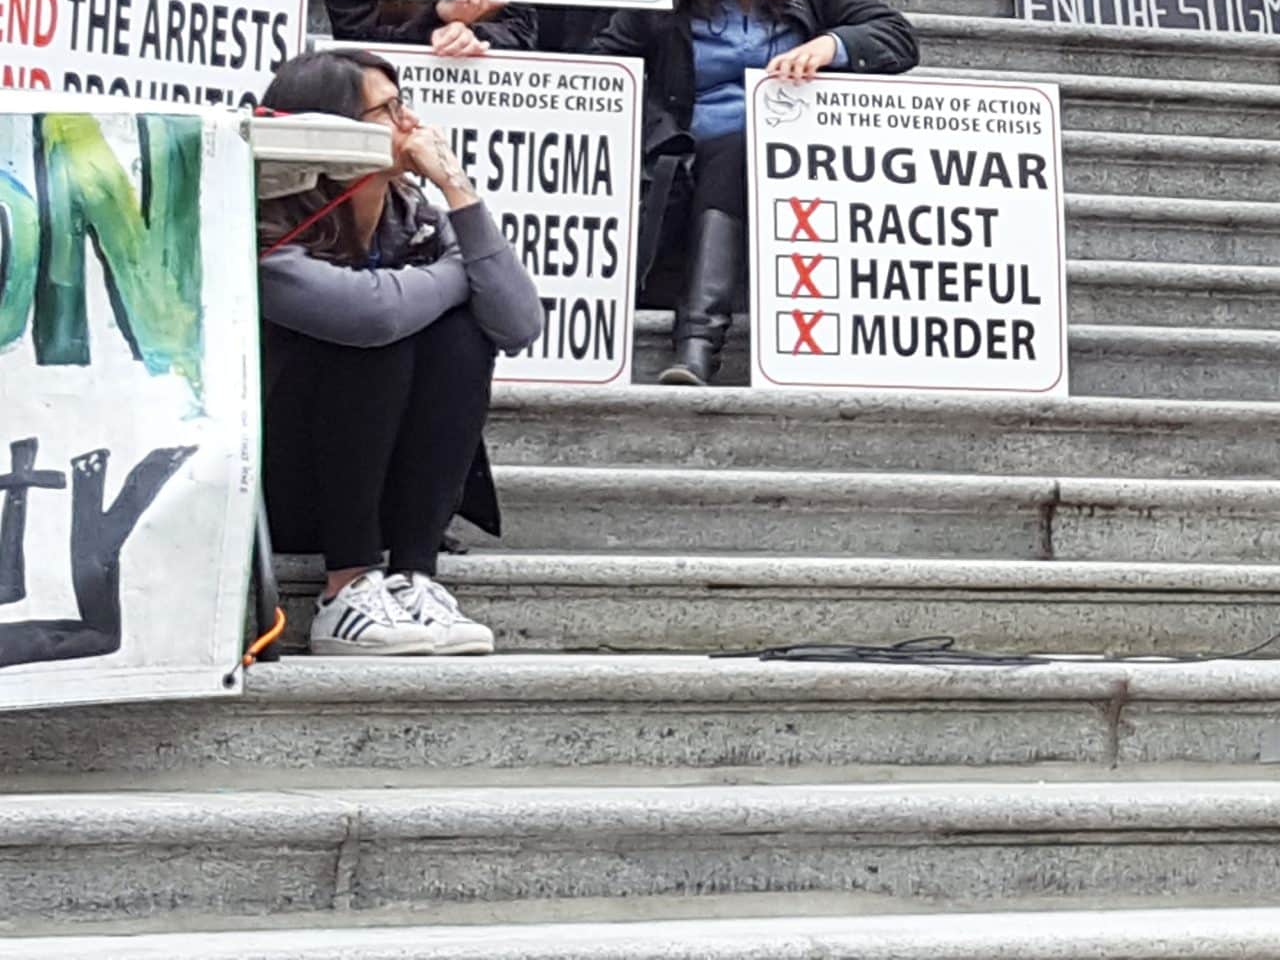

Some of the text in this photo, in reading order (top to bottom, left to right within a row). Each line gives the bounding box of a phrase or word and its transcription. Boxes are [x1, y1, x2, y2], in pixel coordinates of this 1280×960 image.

[397, 65, 625, 92] ATIONAL DAY OF ACTION
[420, 87, 456, 104] THE
[461, 90, 559, 109] OVERDOSE
[565, 95, 624, 113] CRISIS
[816, 91, 1041, 116] NATIONAL DAY OF ACTION
[817, 111, 1042, 135] ON THE OVERDOSE CRISIS
[487, 129, 613, 196] STIGMA
[766, 142, 1049, 190] DRUG WAR
[849, 202, 999, 247] RACIST
[850, 258, 1042, 306] HATEFUL
[851, 314, 1037, 360] MURDER
